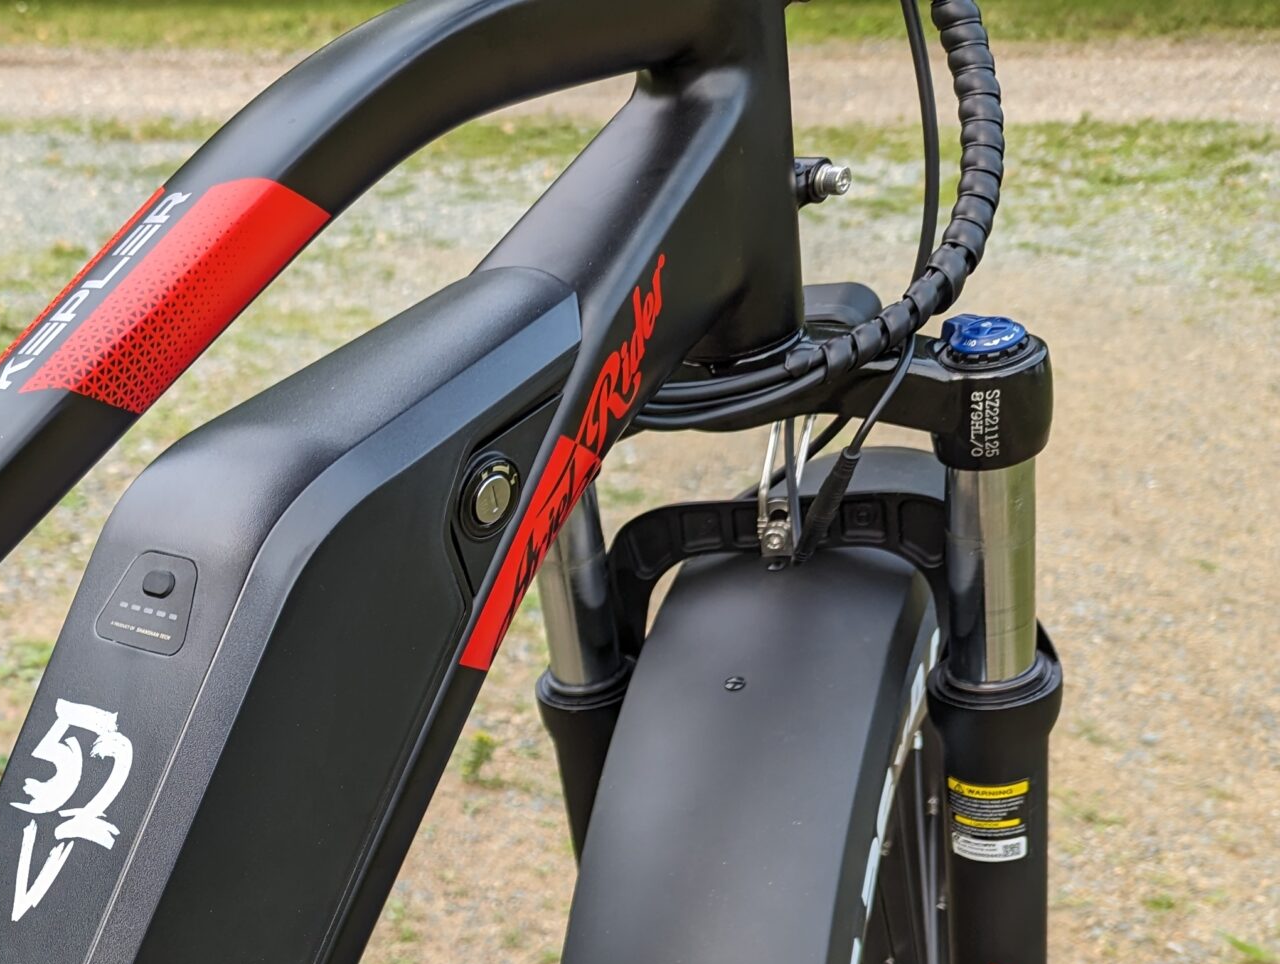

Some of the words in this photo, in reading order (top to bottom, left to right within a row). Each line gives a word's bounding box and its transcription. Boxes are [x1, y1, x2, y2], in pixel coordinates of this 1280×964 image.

[556, 253, 666, 485] Rider
[985, 389, 1001, 458] SZ221125
[966, 788, 1014, 797] WARNING
